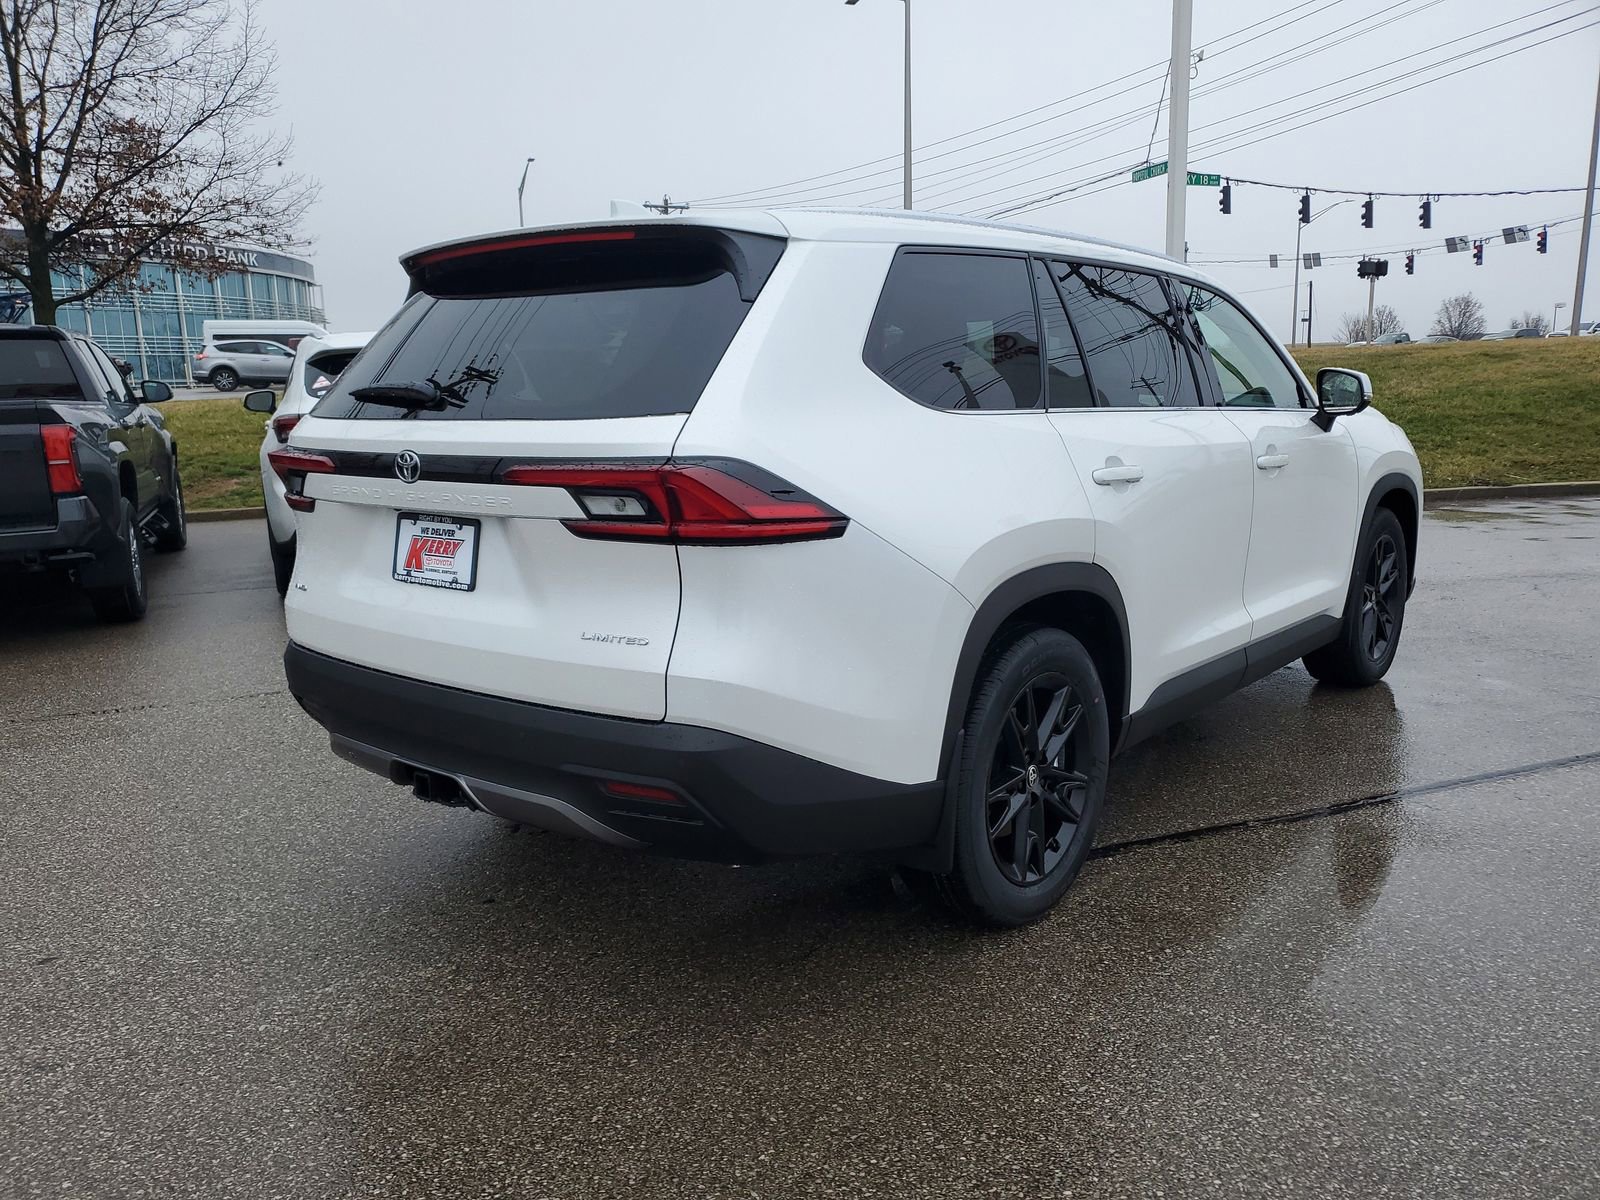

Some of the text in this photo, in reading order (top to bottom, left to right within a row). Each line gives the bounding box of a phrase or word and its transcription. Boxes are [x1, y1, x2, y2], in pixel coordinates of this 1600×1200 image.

[1200, 175, 1209, 185] 18
[214, 246, 258, 267] BANK
[332, 485, 382, 499] GRAND
[420, 527, 456, 537] WE DELIVER
[403, 535, 464, 573] KERRY
[433, 558, 453, 567] TOYOTA
[394, 573, 468, 590] kerryautomotive.com
[580, 631, 649, 646] LIMITED
